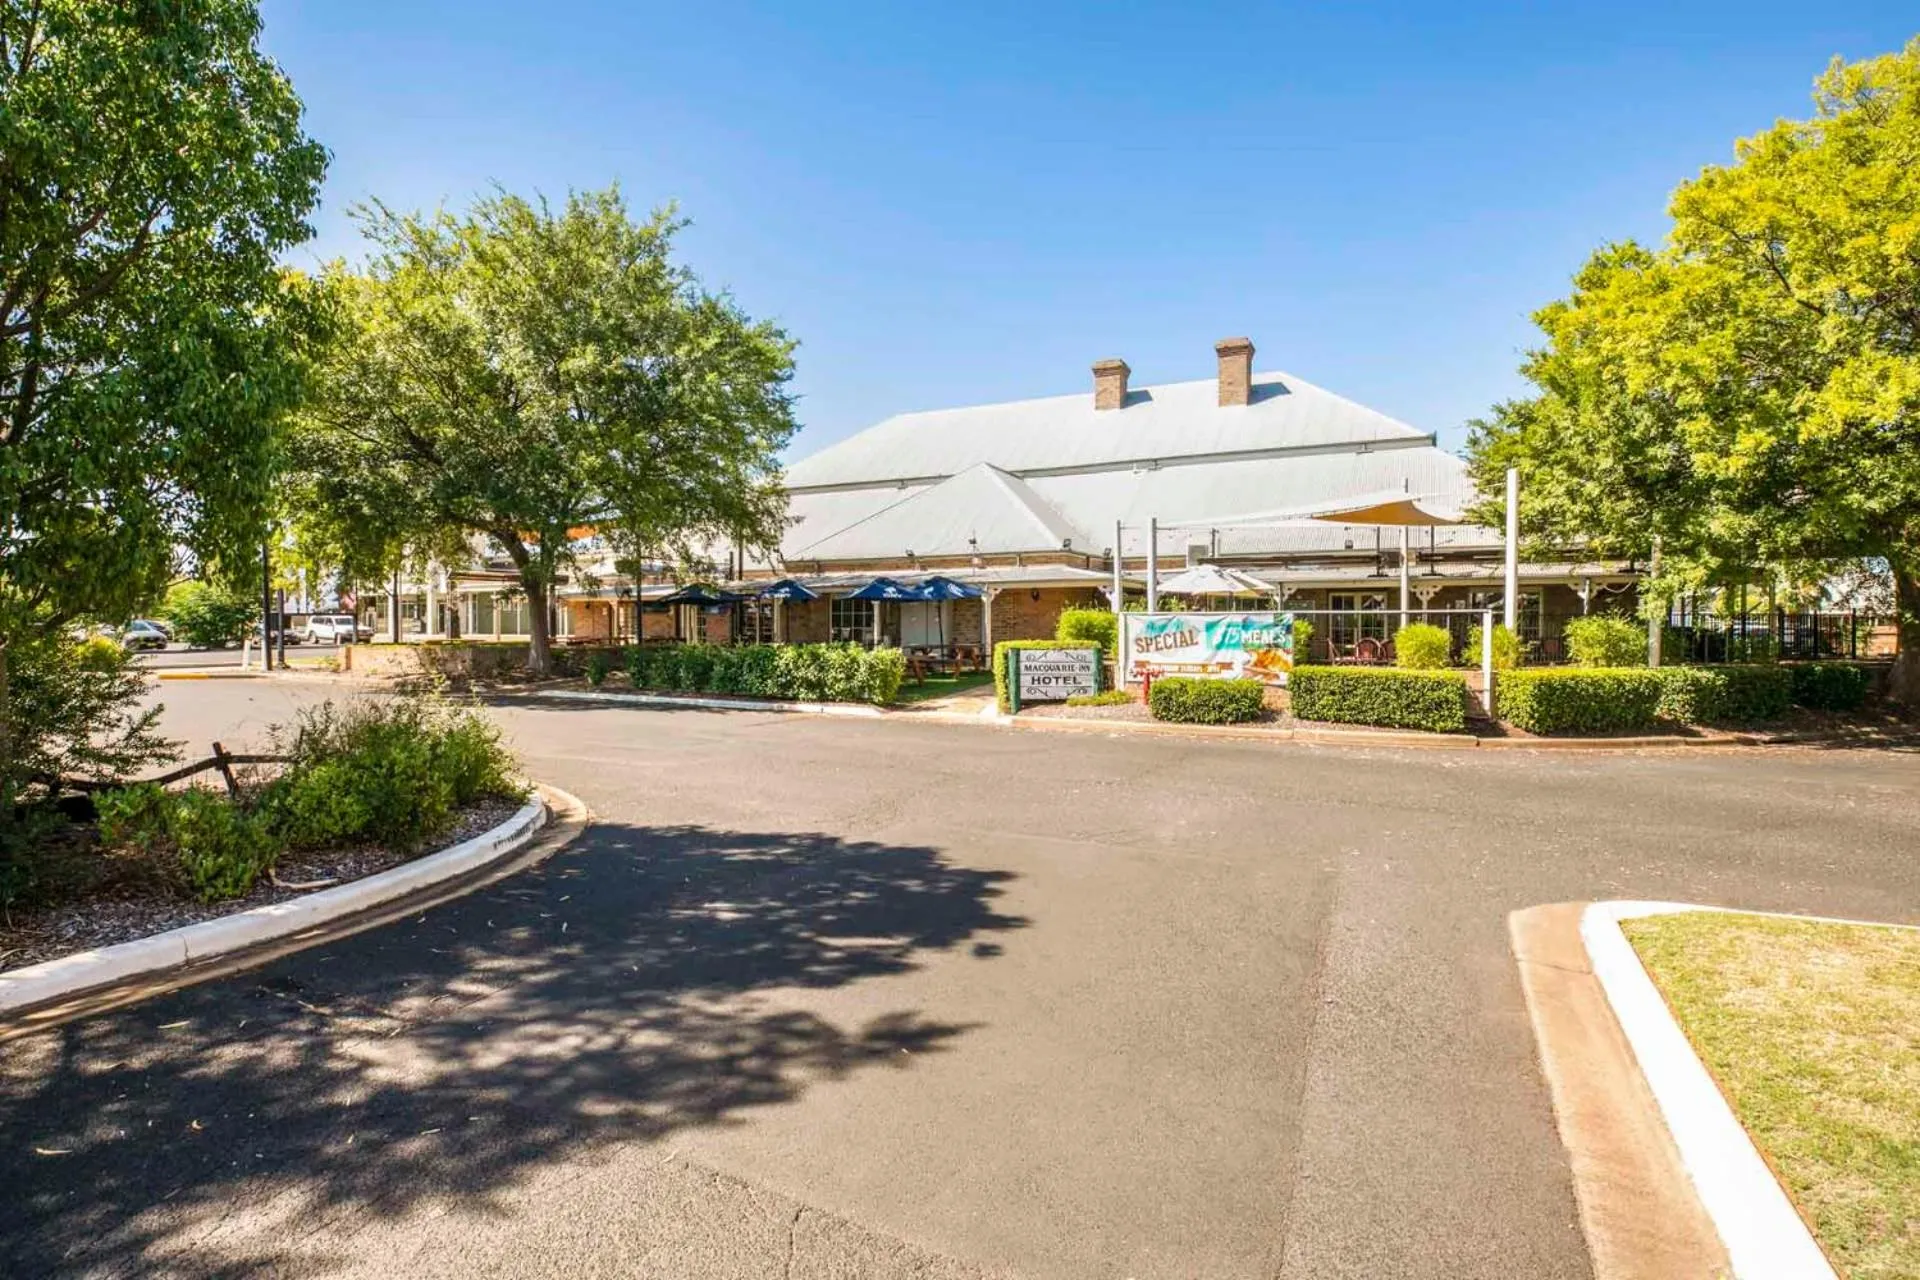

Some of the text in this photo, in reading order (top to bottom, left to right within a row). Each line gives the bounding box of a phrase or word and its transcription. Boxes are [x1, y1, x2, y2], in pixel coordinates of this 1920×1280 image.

[1135, 630, 1199, 653] SPECIAL
[1241, 628, 1286, 645] MEALS
[1024, 664, 1075, 673] MACQUARIE
[1031, 676, 1082, 686] HOTEL
